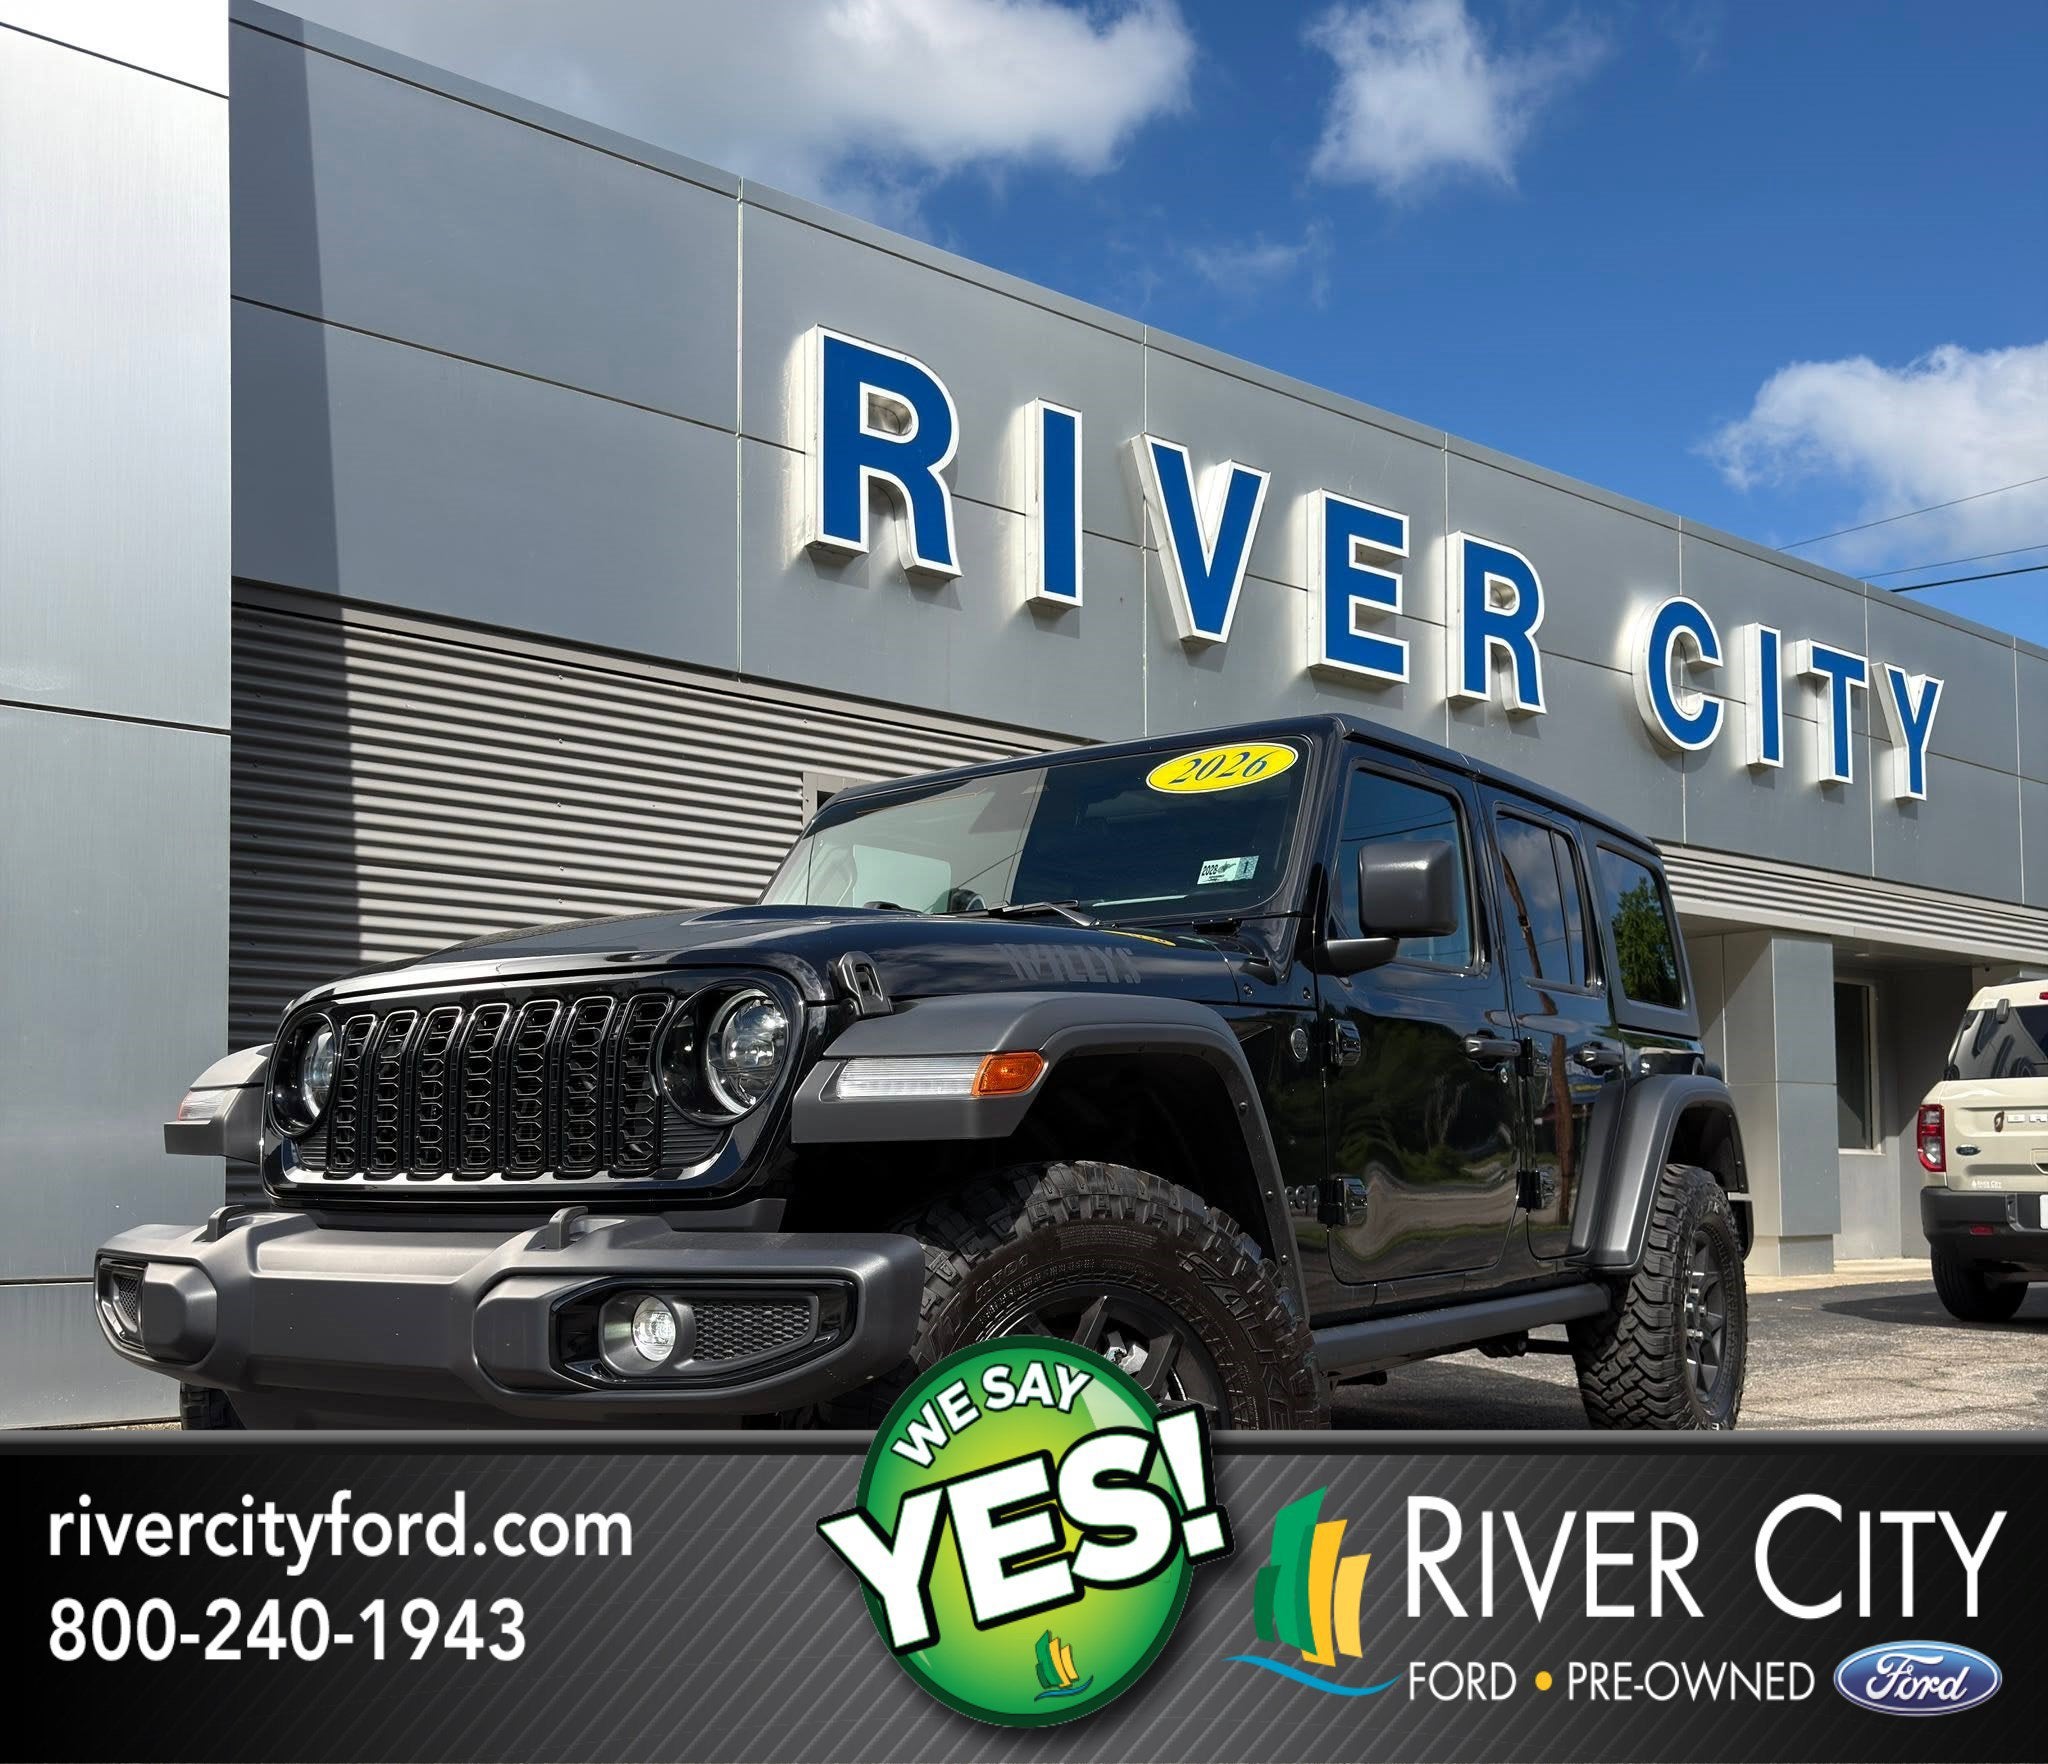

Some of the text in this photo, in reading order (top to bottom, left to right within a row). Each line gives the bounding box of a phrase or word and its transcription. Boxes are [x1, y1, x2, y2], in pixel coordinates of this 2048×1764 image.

[808, 324, 1944, 801] RIVER CITY
[1168, 750, 1280, 784] 2026
[993, 943, 1142, 984] WILLYS
[1284, 1184, 1321, 1215] eep
[1175, 1250, 1291, 1430] FALKE
